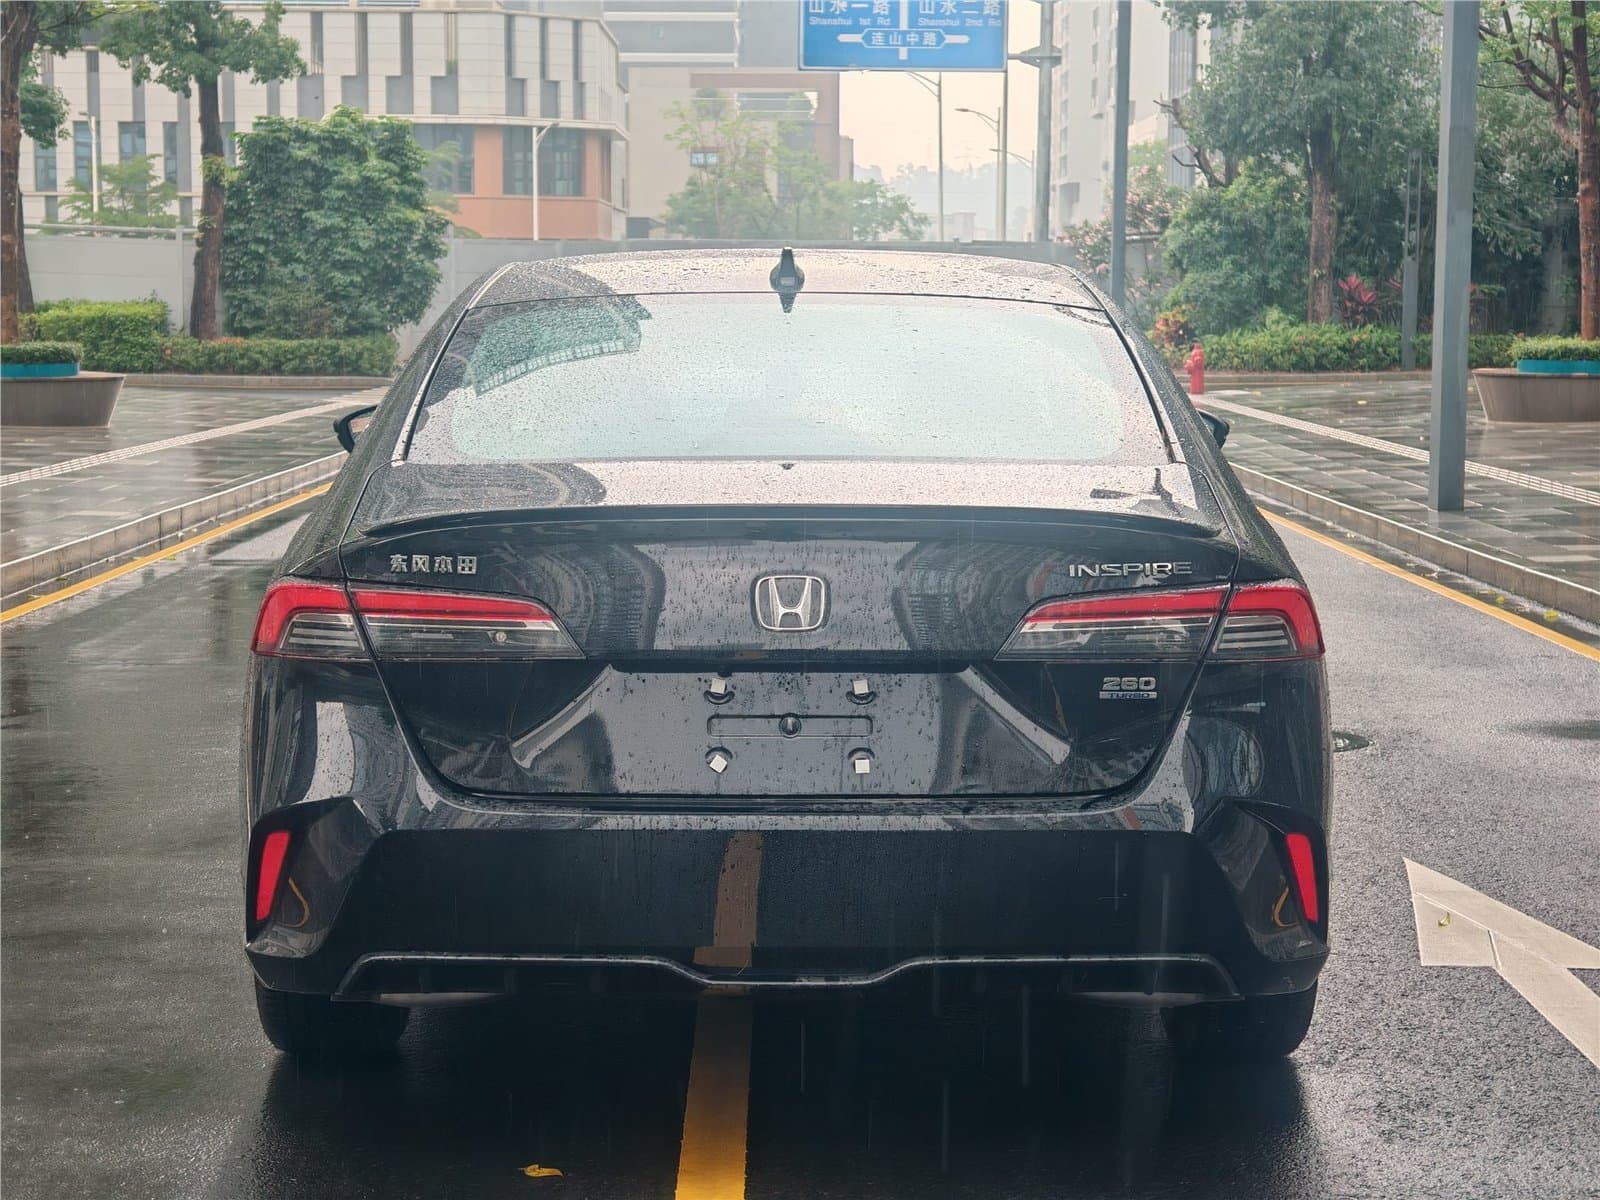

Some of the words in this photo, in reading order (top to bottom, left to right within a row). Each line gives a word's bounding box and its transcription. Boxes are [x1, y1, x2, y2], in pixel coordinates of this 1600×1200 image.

[809, 0, 890, 15] 山水一路
[920, 0, 1000, 16] 山水二路
[809, 16, 852, 25] Shanshui
[877, 17, 891, 25] Rd
[918, 17, 960, 26] Shanshui
[965, 18, 982, 26] 2nd
[871, 31, 937, 46] 连山中路
[389, 553, 478, 575] 东风本田
[1068, 561, 1193, 577] INSPIRE
[1102, 676, 1157, 691] 260
